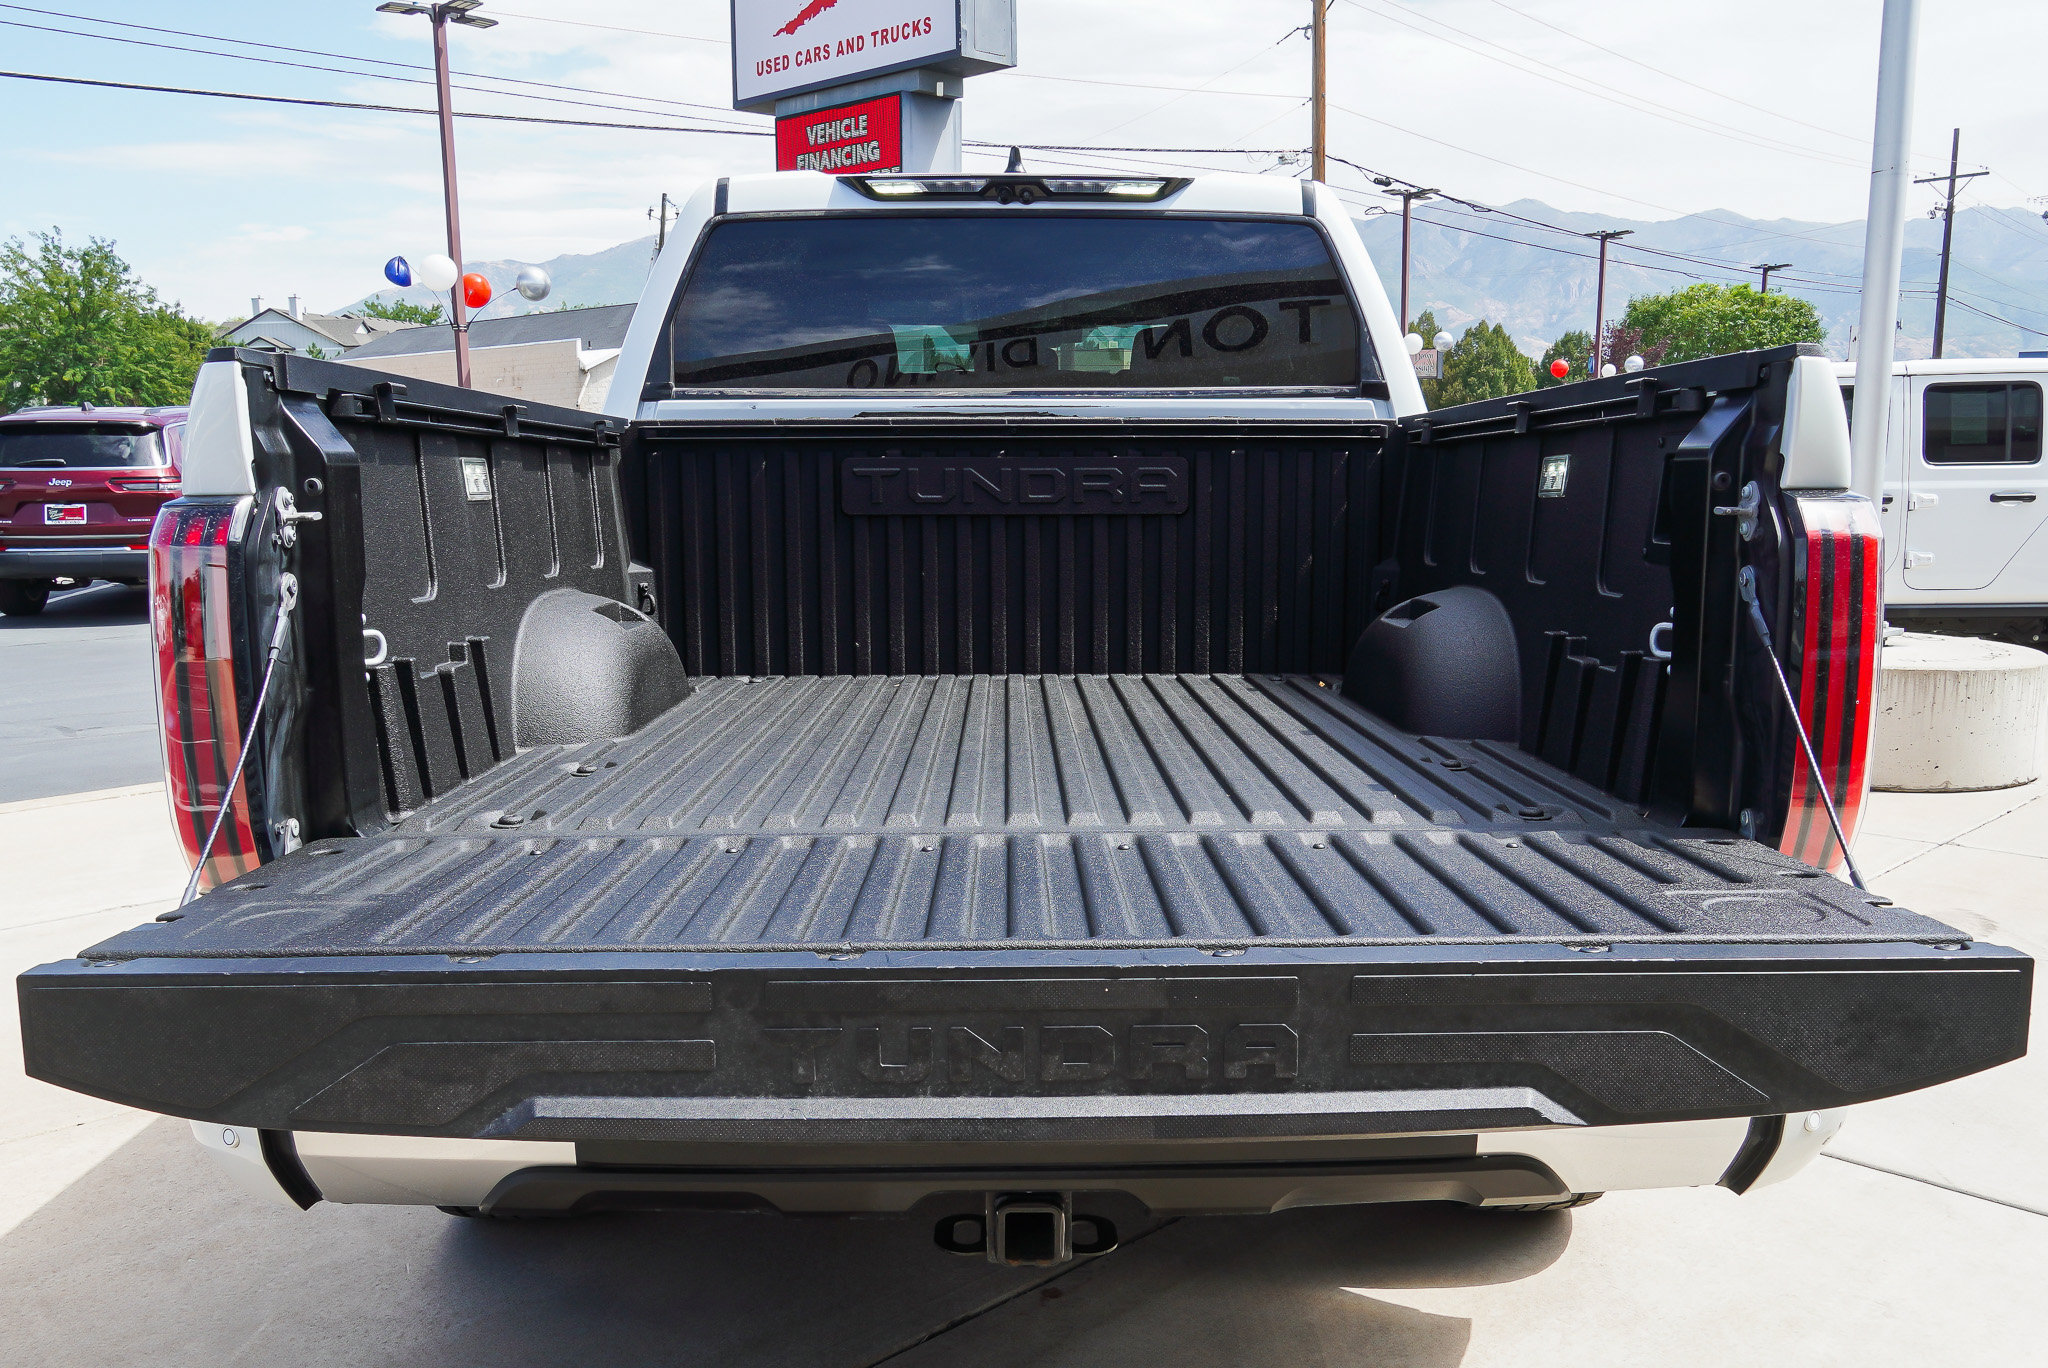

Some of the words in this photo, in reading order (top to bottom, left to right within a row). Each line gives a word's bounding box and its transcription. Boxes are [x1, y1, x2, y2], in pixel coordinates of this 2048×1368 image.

[756, 57, 790, 77] USED
[795, 43, 831, 67] CARS
[836, 34, 865, 58] AND
[871, 16, 933, 48] TRUCKS
[805, 114, 868, 147] VEHICLE
[796, 139, 881, 172] FINANCING
[48, 478, 73, 488] Jeep
[852, 467, 1179, 504] TUNDRA
[761, 1022, 1299, 1085] TUNDRA
